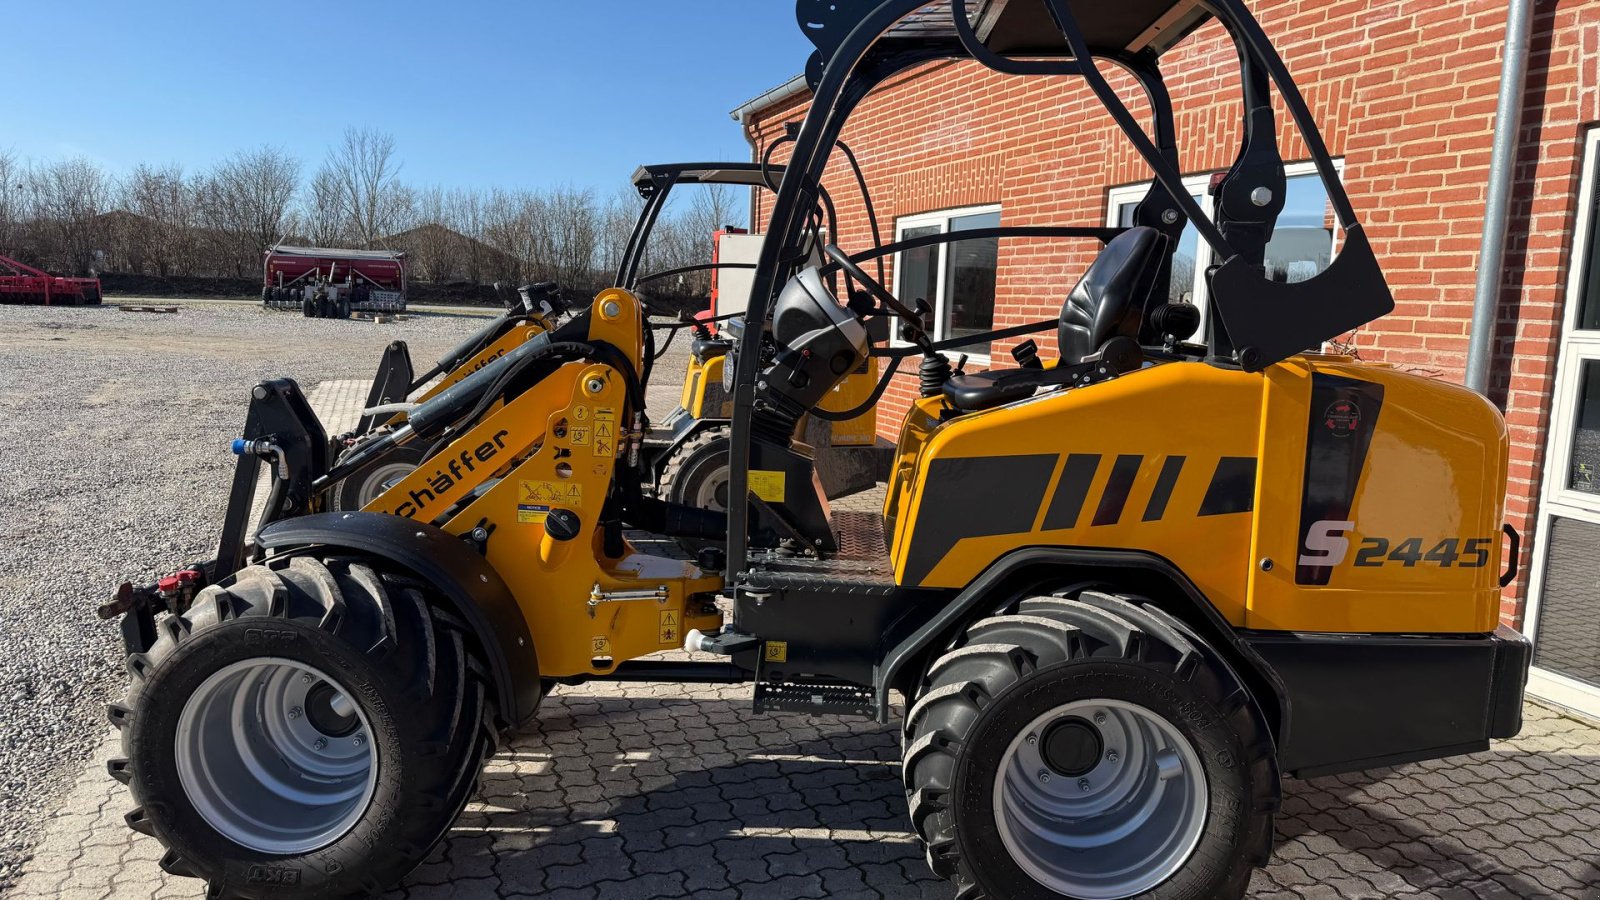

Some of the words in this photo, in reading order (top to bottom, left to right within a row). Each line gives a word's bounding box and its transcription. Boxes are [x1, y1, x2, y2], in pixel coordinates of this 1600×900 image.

[382, 429, 509, 518] chäffer
[1298, 520, 1355, 566] S
[1353, 537, 1492, 567] 2445
